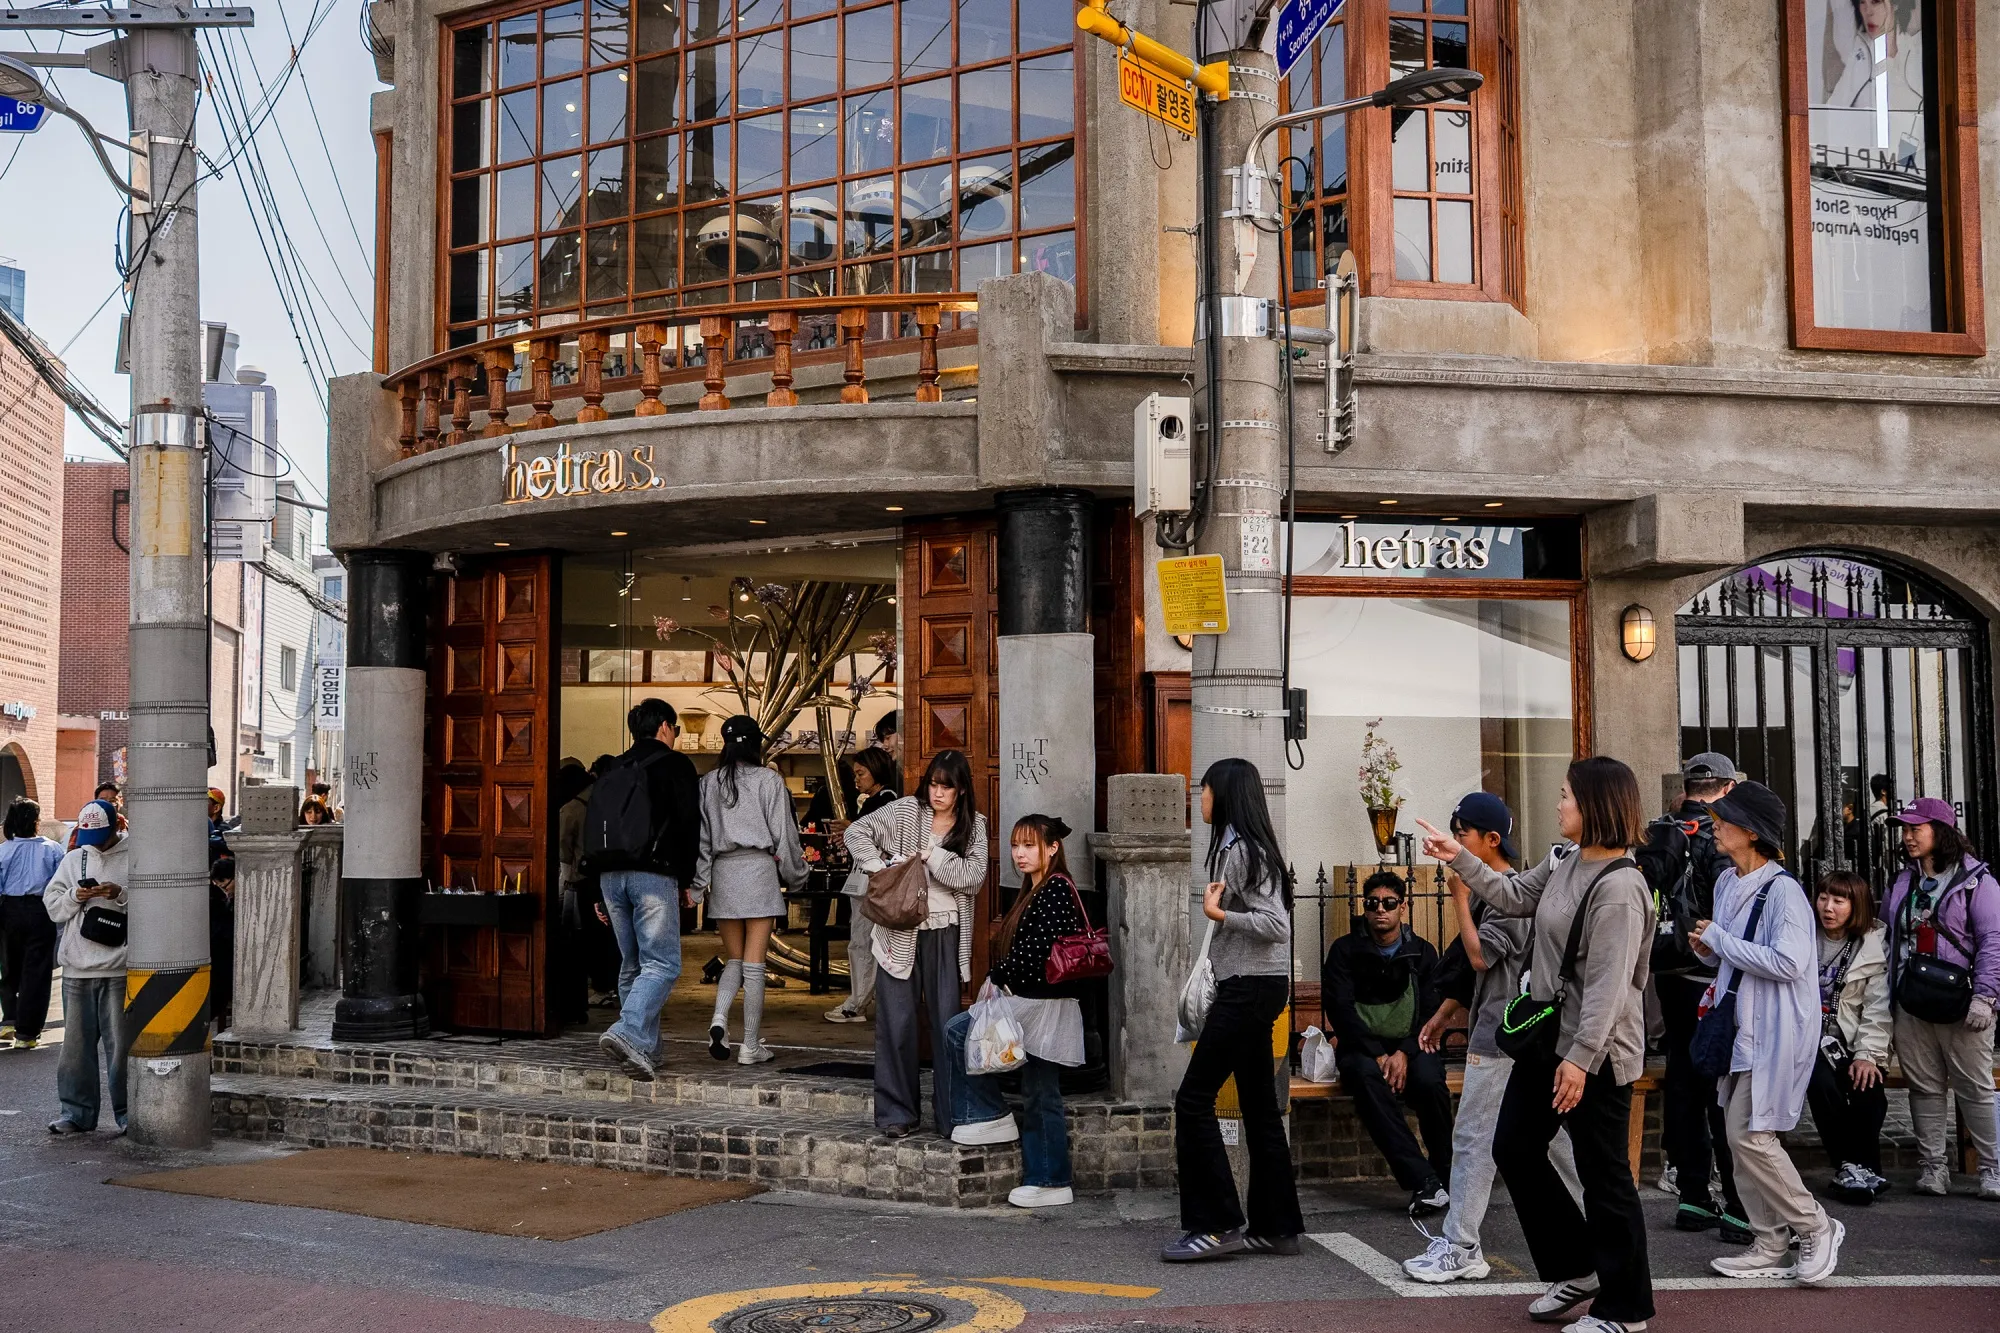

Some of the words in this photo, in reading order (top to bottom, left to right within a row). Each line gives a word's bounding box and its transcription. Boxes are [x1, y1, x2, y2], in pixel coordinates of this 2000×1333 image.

[1123, 66, 1152, 107] CCTV
[16, 100, 37, 115] 66
[1339, 520, 1490, 570] hetras
[321, 667, 340, 718] 진영합지
[100, 711, 130, 721] F.ILL
